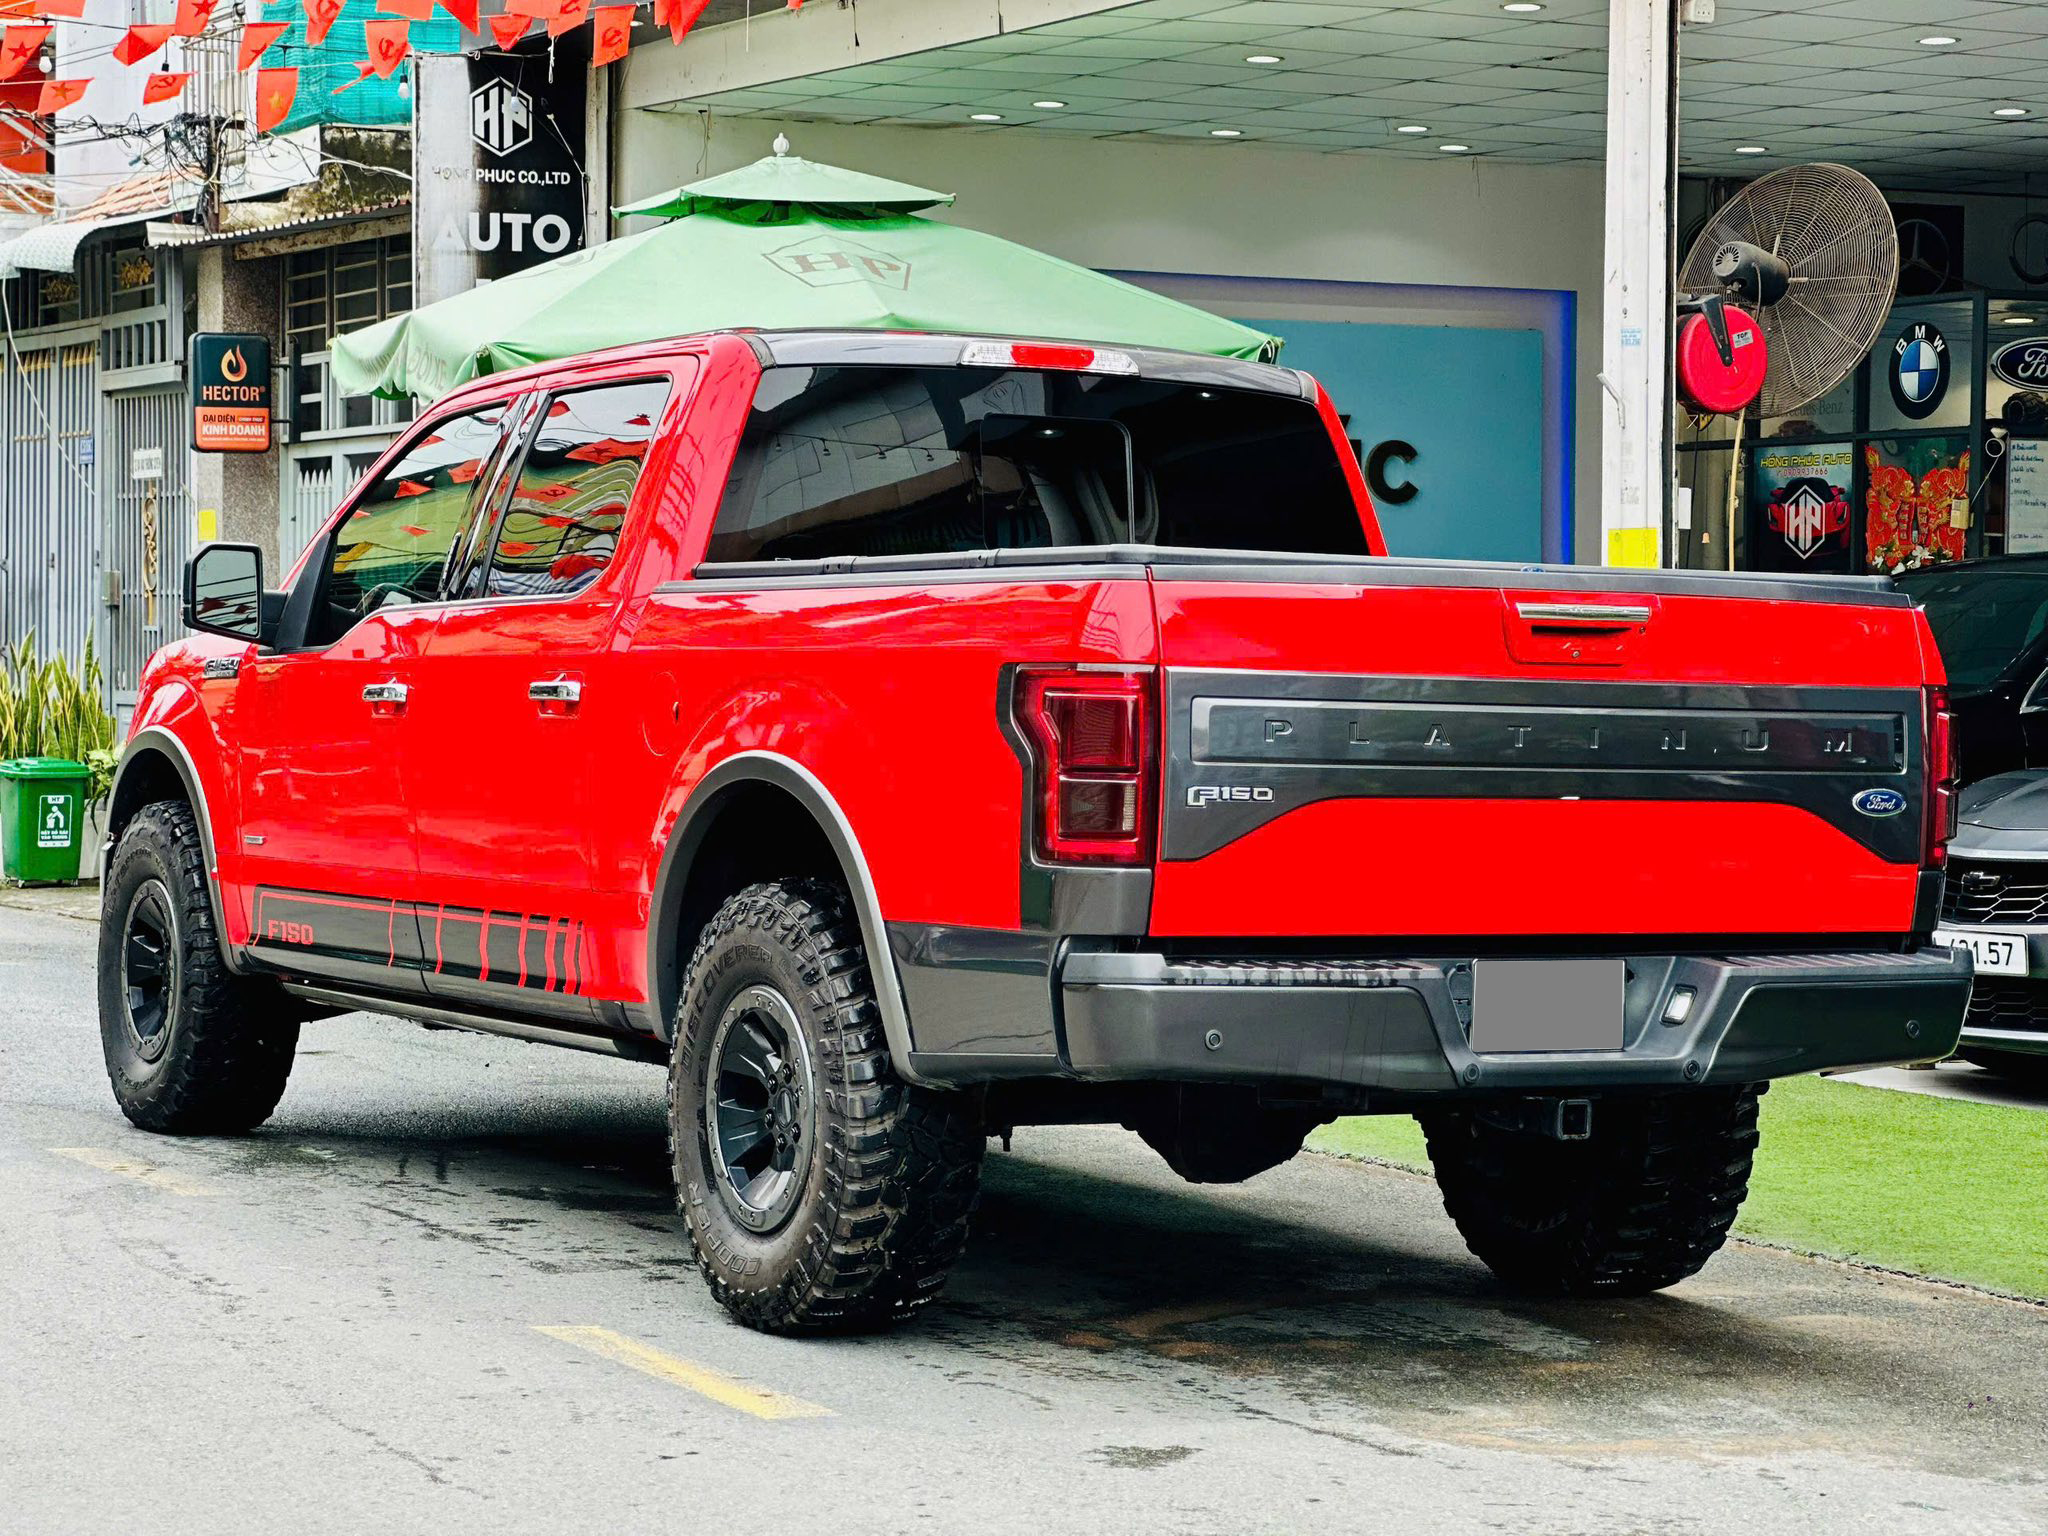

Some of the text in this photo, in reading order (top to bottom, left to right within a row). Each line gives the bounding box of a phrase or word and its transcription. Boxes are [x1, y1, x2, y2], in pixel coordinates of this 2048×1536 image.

[475, 168, 516, 183] PHUC
[518, 170, 571, 186] CO.,LTD
[432, 212, 571, 254] AUTO
[1895, 325, 1946, 356] BMW
[203, 385, 260, 402] HECTOR
[202, 424, 266, 436] KINH DOANH
[1822, 453, 1853, 465] AUTO
[1264, 718, 1852, 753] PLATINUM
[1866, 794, 1896, 810] Ford
[268, 919, 314, 945] F150
